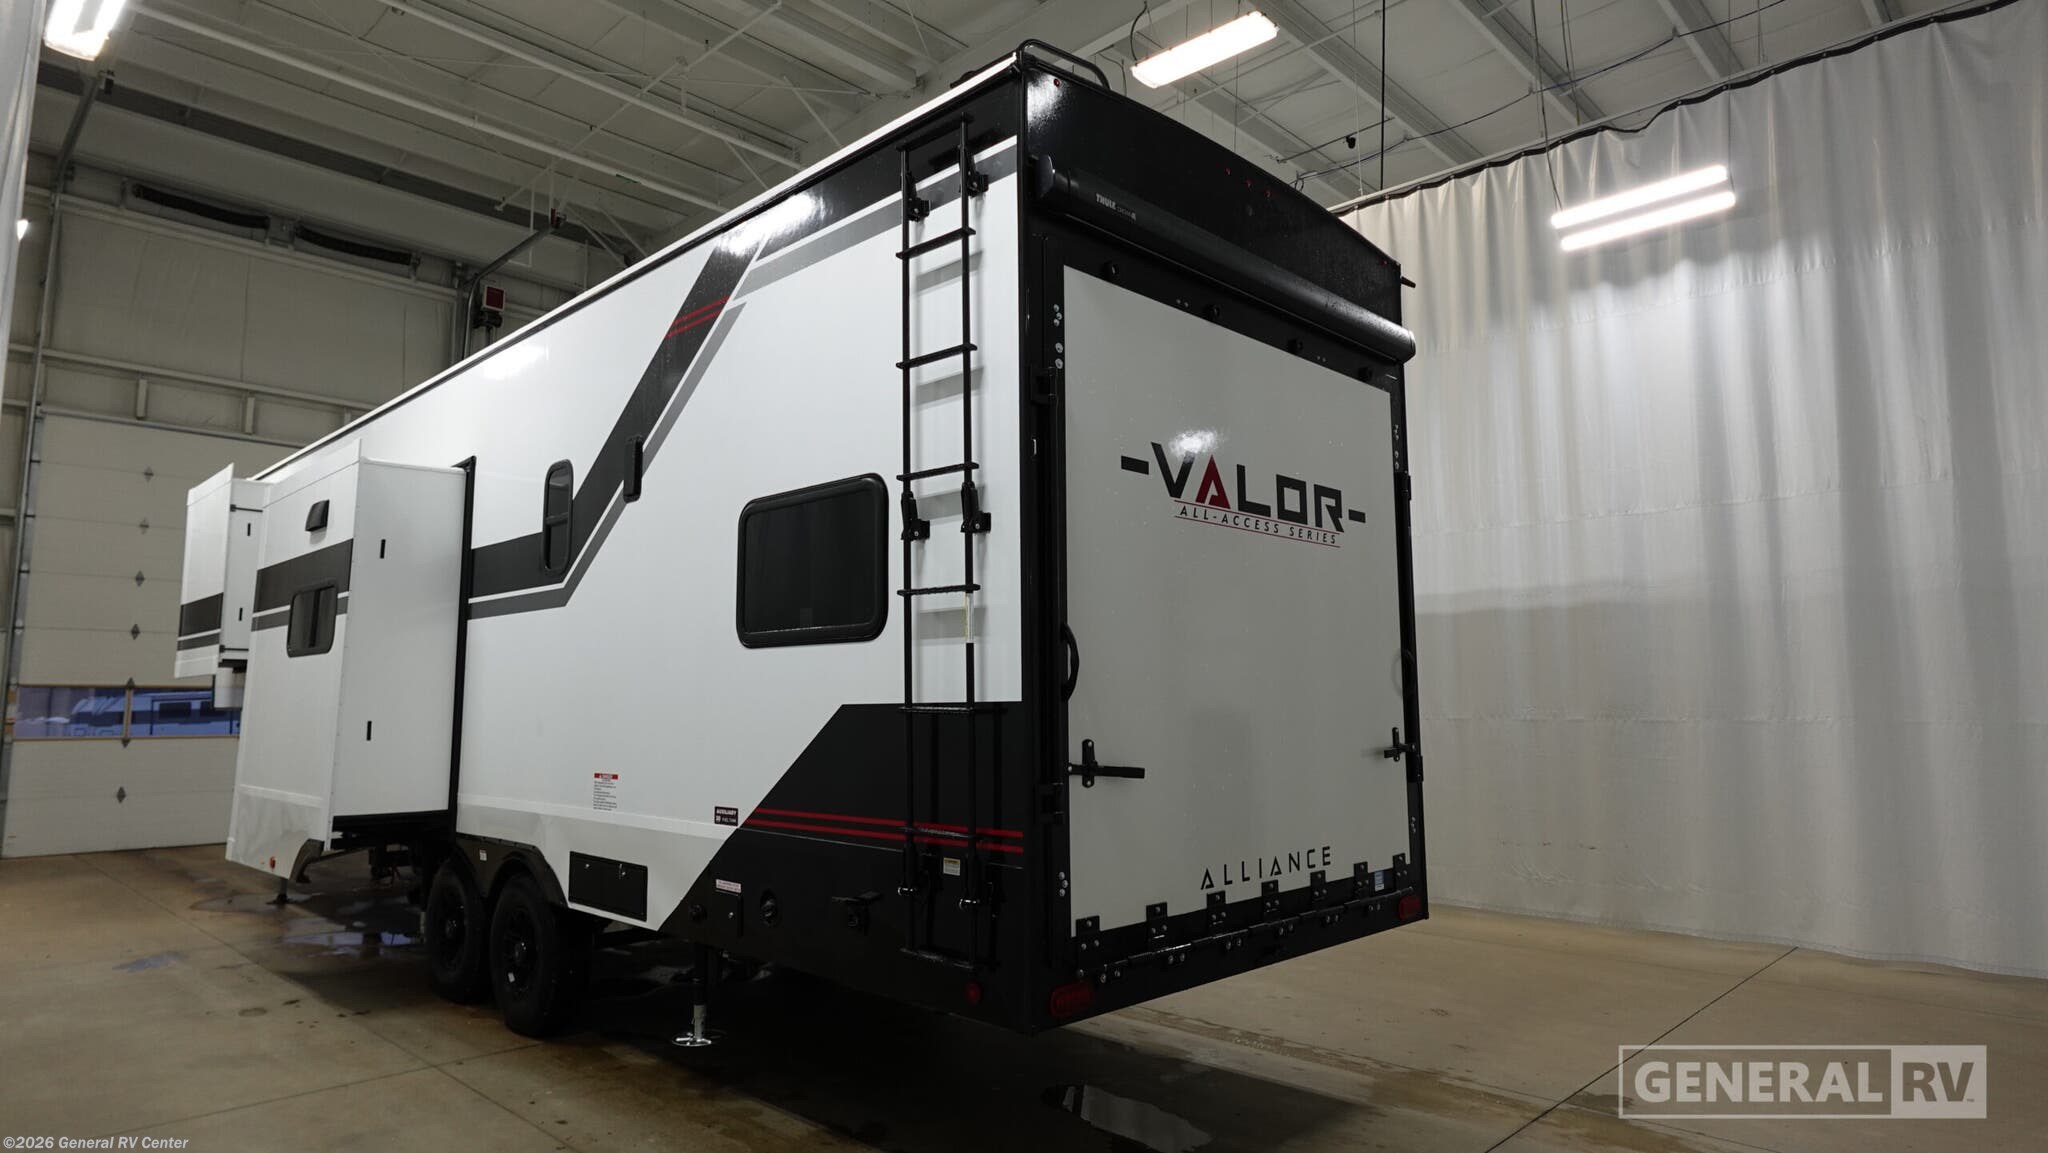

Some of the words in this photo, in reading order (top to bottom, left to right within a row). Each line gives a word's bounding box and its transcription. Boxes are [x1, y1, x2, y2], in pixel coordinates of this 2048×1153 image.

[1096, 193, 1116, 210] THULE
[1180, 505, 1279, 534] ALL-ACCESS
[1289, 526, 1336, 545] SERIES
[1200, 846, 1331, 890] ALLIANCE
